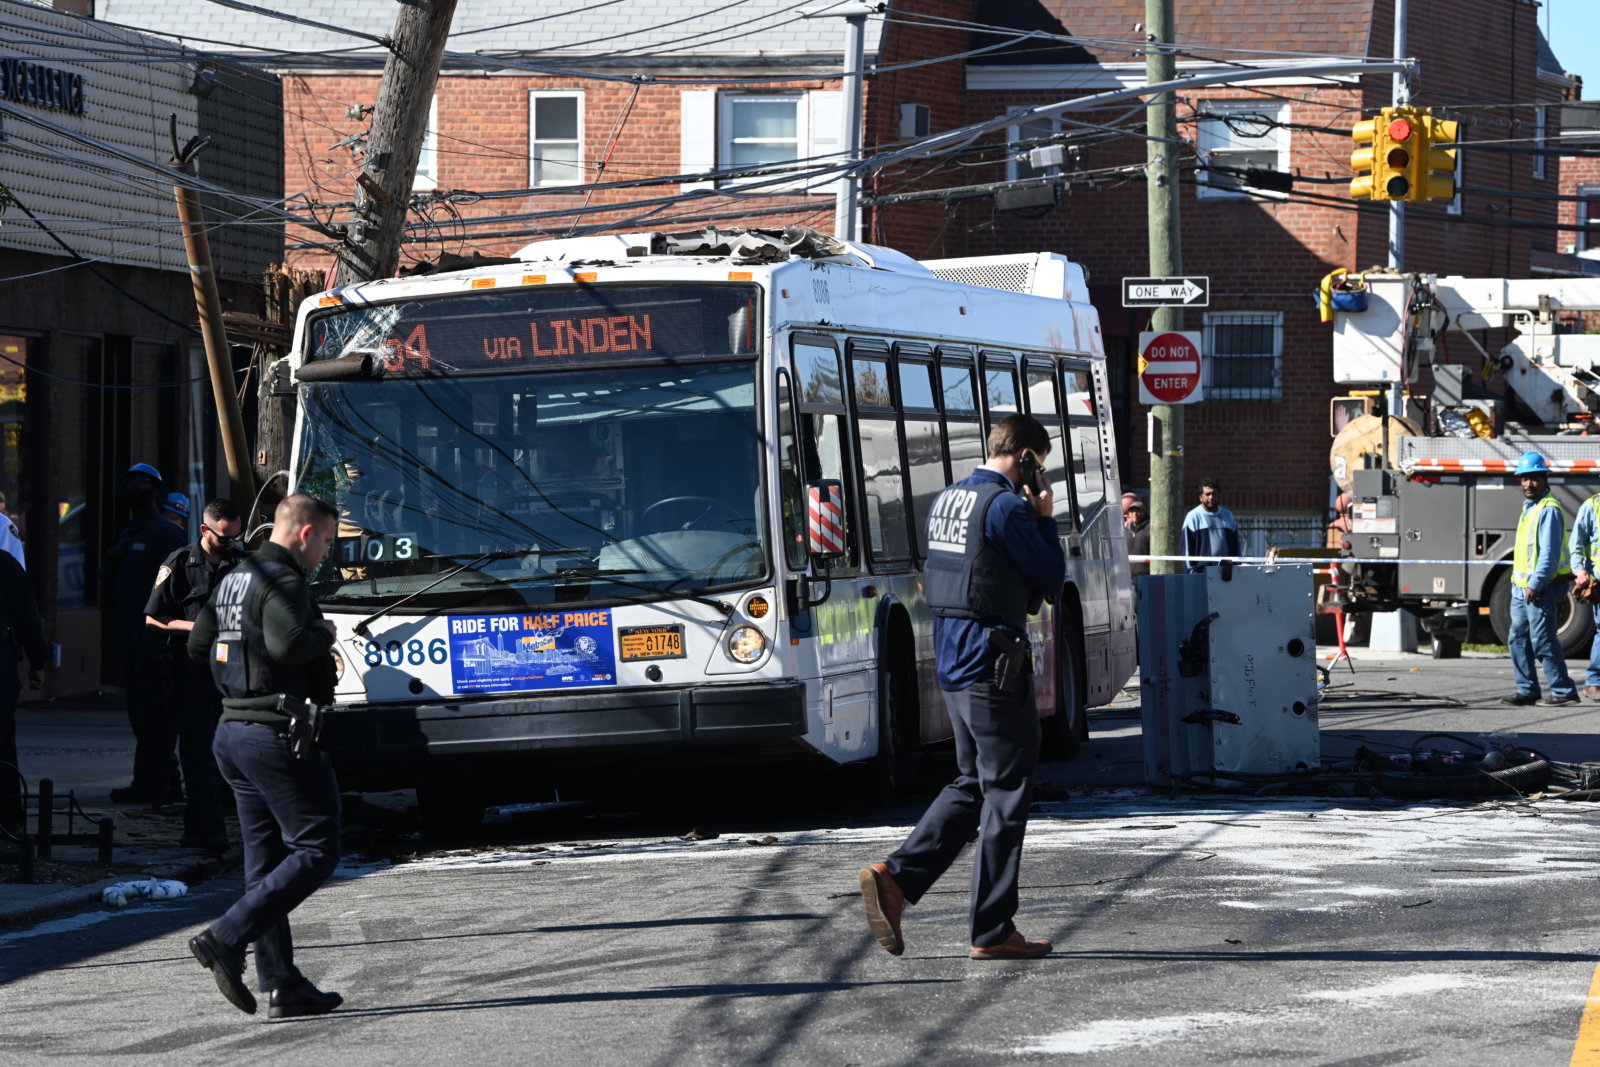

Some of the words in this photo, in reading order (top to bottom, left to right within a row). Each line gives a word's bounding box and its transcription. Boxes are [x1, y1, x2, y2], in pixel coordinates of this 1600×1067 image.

[1135, 286, 1160, 298] ONE
[1170, 286, 1196, 298] WAY
[483, 336, 523, 360] VIA
[530, 314, 652, 357] LINDEN
[1151, 346, 1167, 358] DO
[1169, 346, 1191, 358] NOT
[1153, 377, 1189, 390] ENTER
[931, 488, 978, 520] NYPD
[928, 516, 969, 545] POLICE
[215, 571, 253, 606] NYPD
[452, 618, 487, 634] RIDE
[490, 616, 519, 633] FOR
[523, 614, 560, 630] HALF
[564, 612, 608, 628] PRICE
[364, 637, 448, 668] 8086
